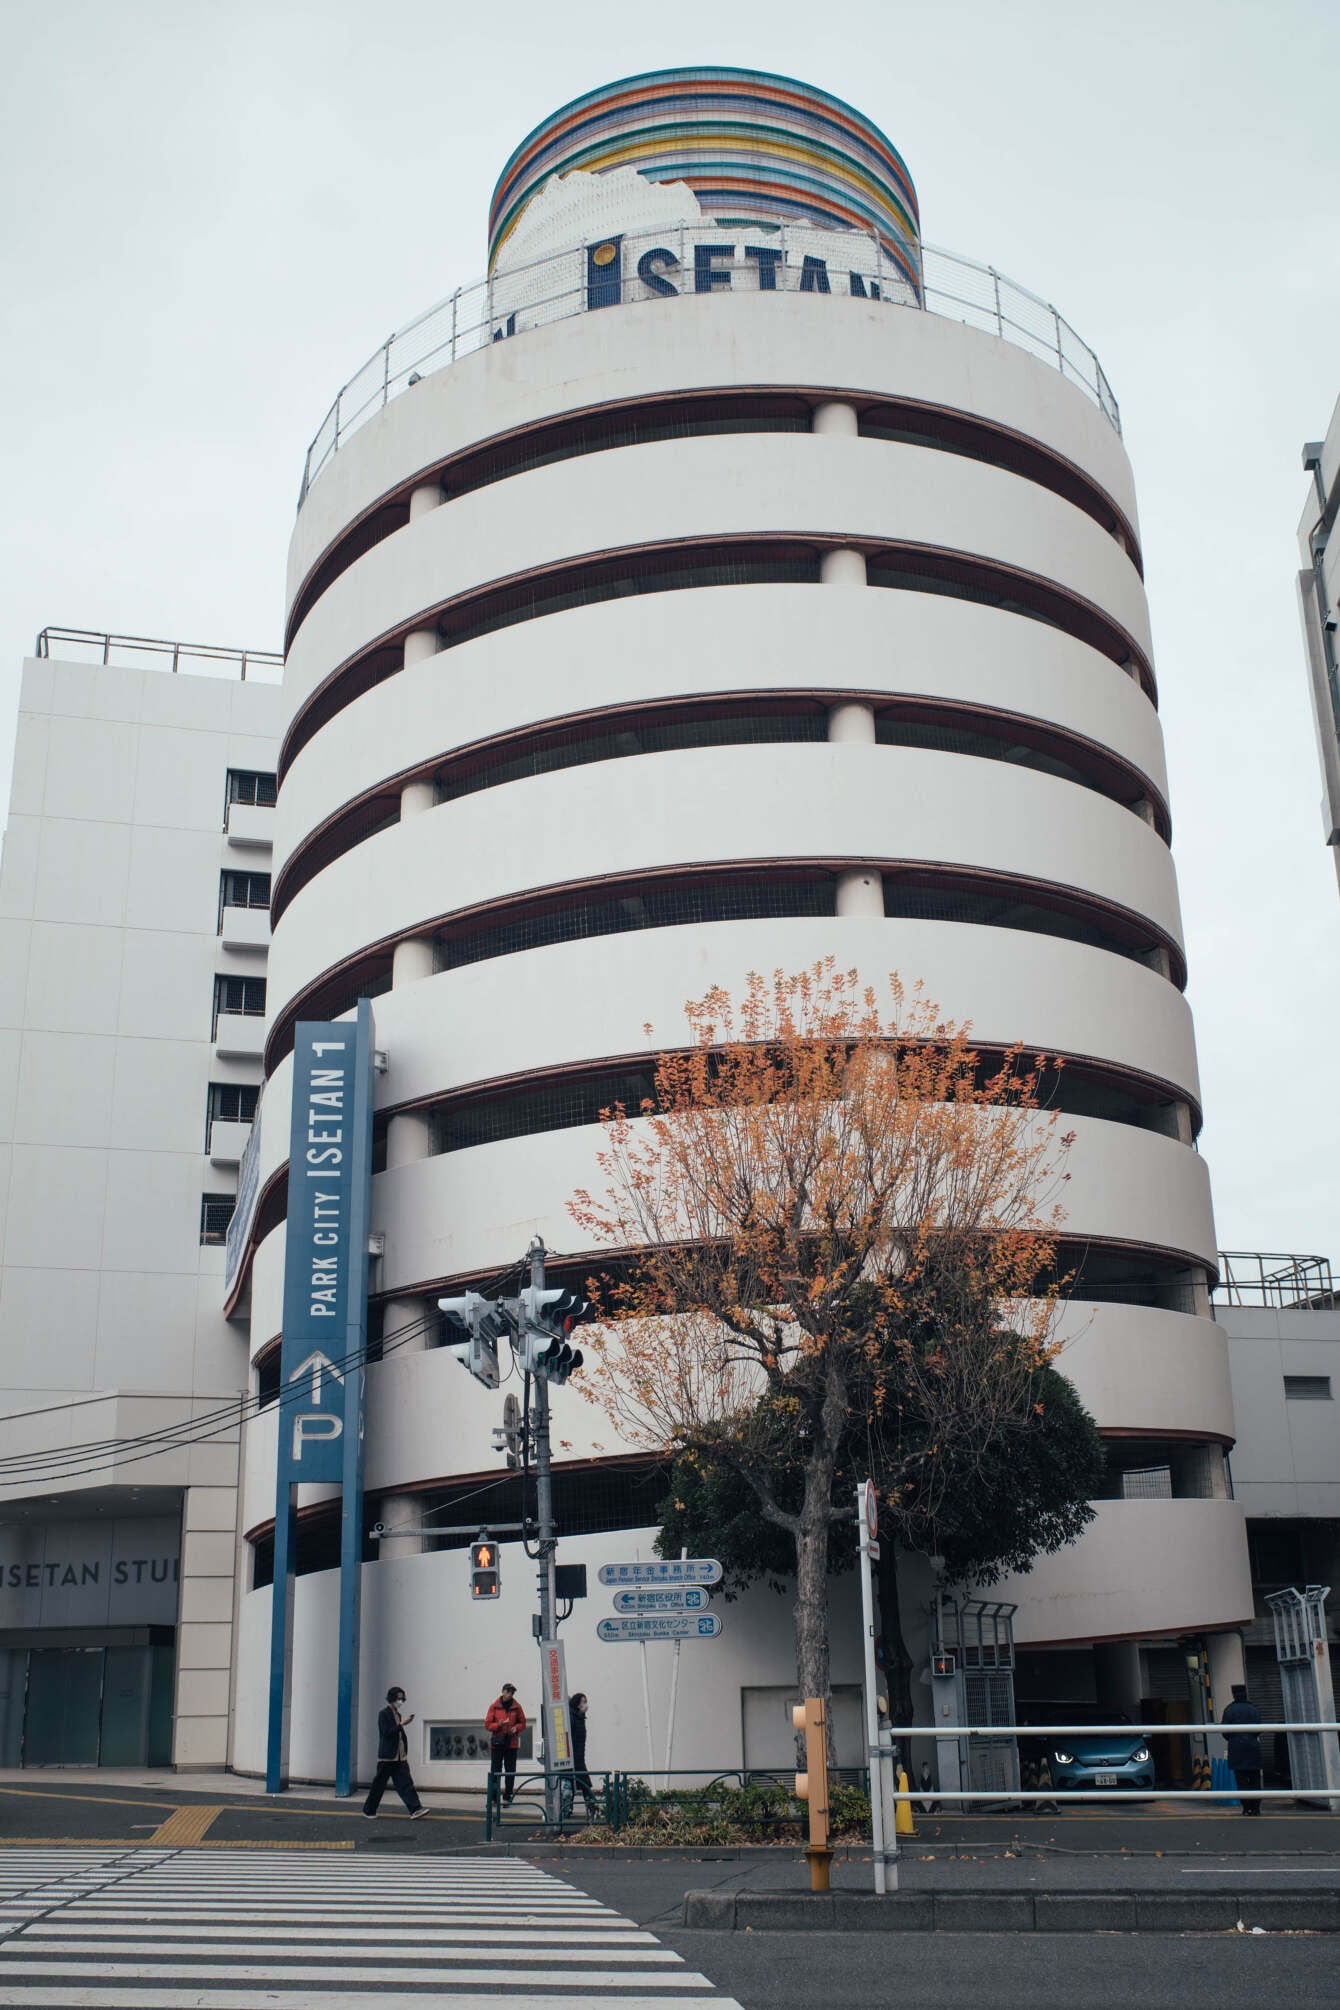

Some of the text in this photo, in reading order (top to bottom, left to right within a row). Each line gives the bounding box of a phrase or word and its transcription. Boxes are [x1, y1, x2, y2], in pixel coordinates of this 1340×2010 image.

[306, 1041, 346, 1318] PARK CITY ISETAN 1
[292, 1413, 343, 1461] P
[0, 1562, 100, 1588] ISETAN
